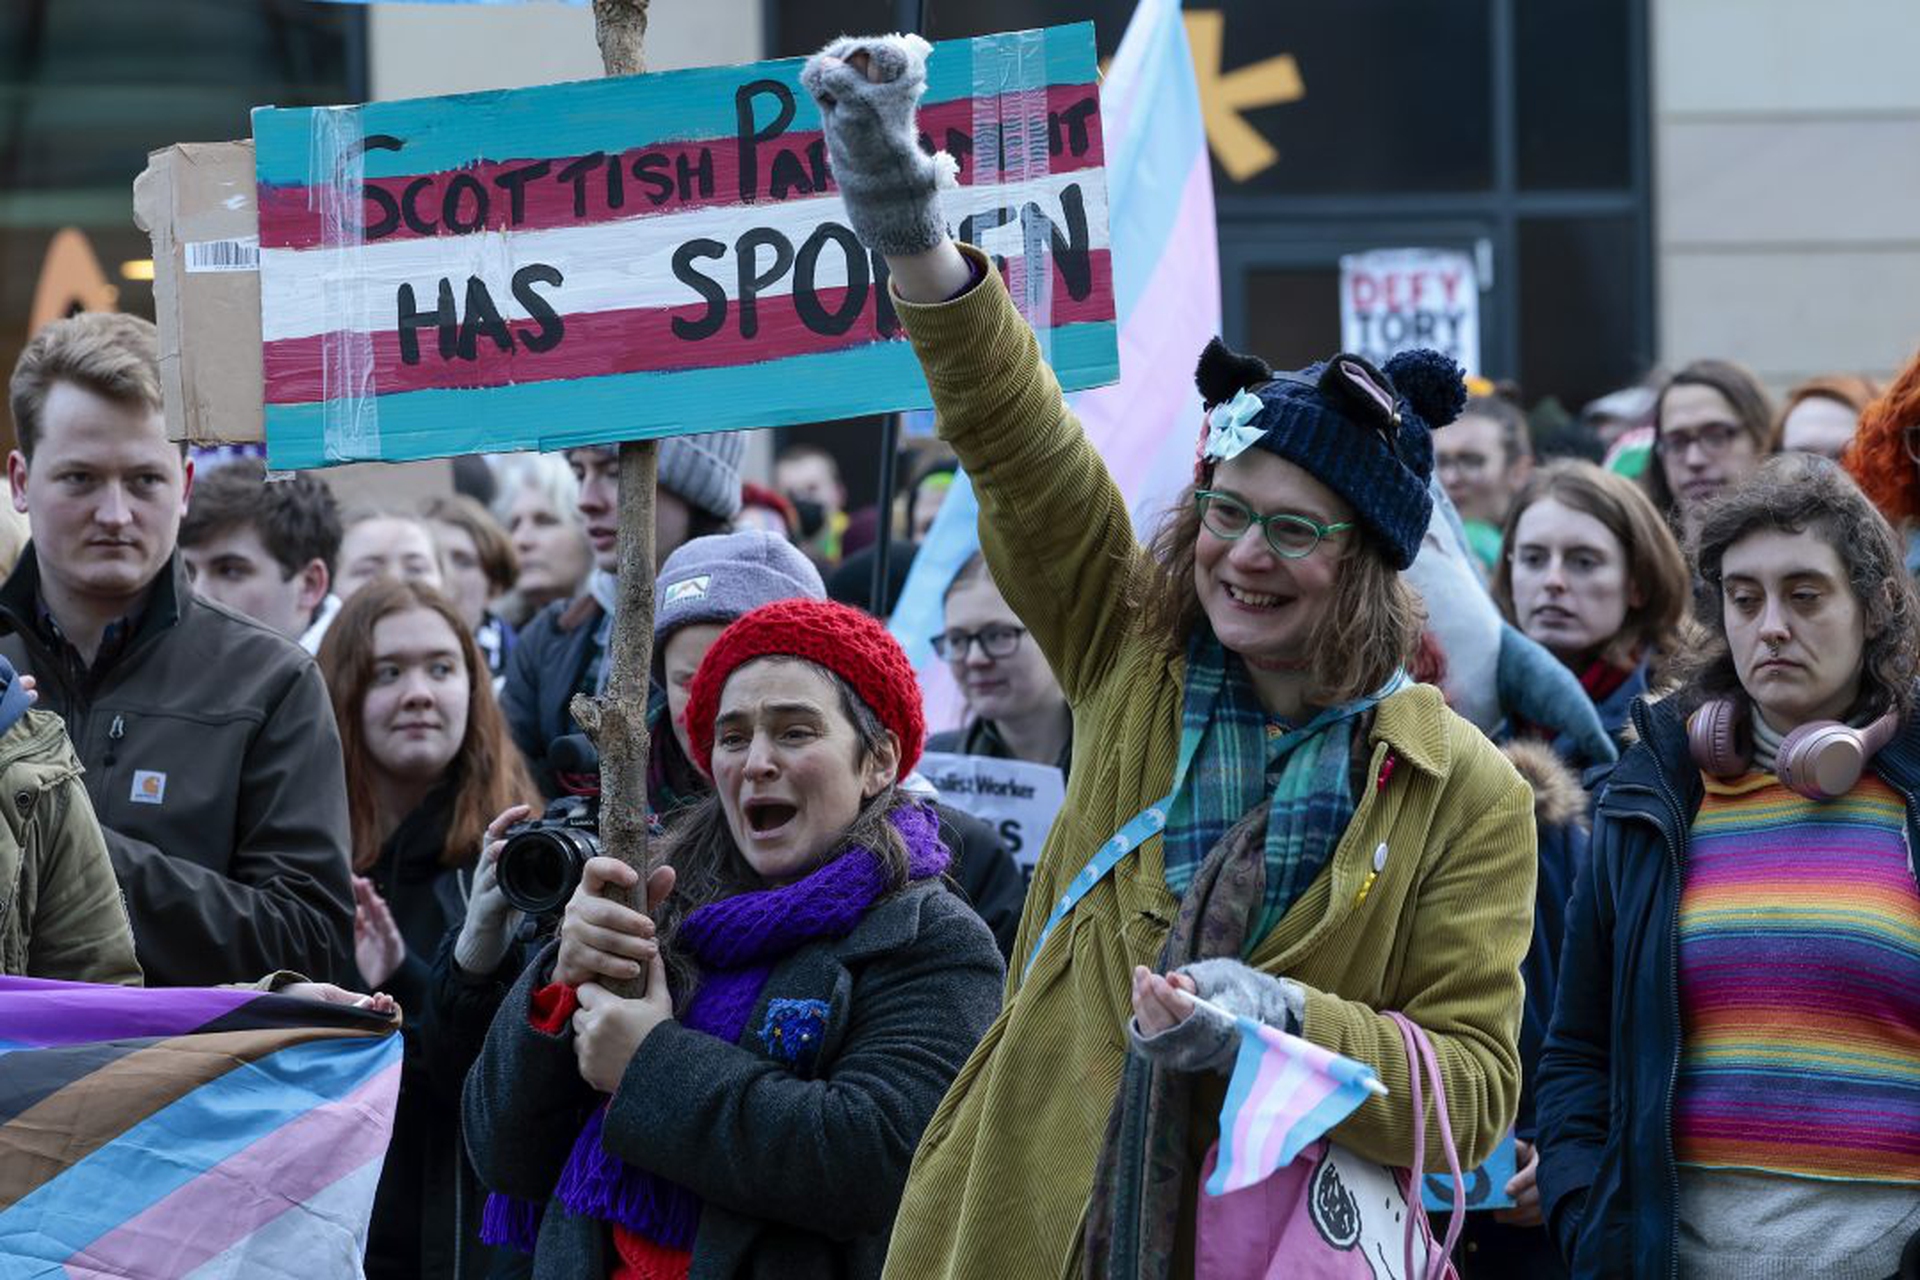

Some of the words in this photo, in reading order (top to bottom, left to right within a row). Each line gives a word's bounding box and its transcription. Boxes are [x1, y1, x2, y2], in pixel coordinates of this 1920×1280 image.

[337, 134, 716, 237] SCOTTISH
[1351, 270, 1462, 312] DEFY
[397, 263, 565, 366] HAS
[1355, 312, 1464, 345] TORY
[975, 774, 1035, 799] Worker
